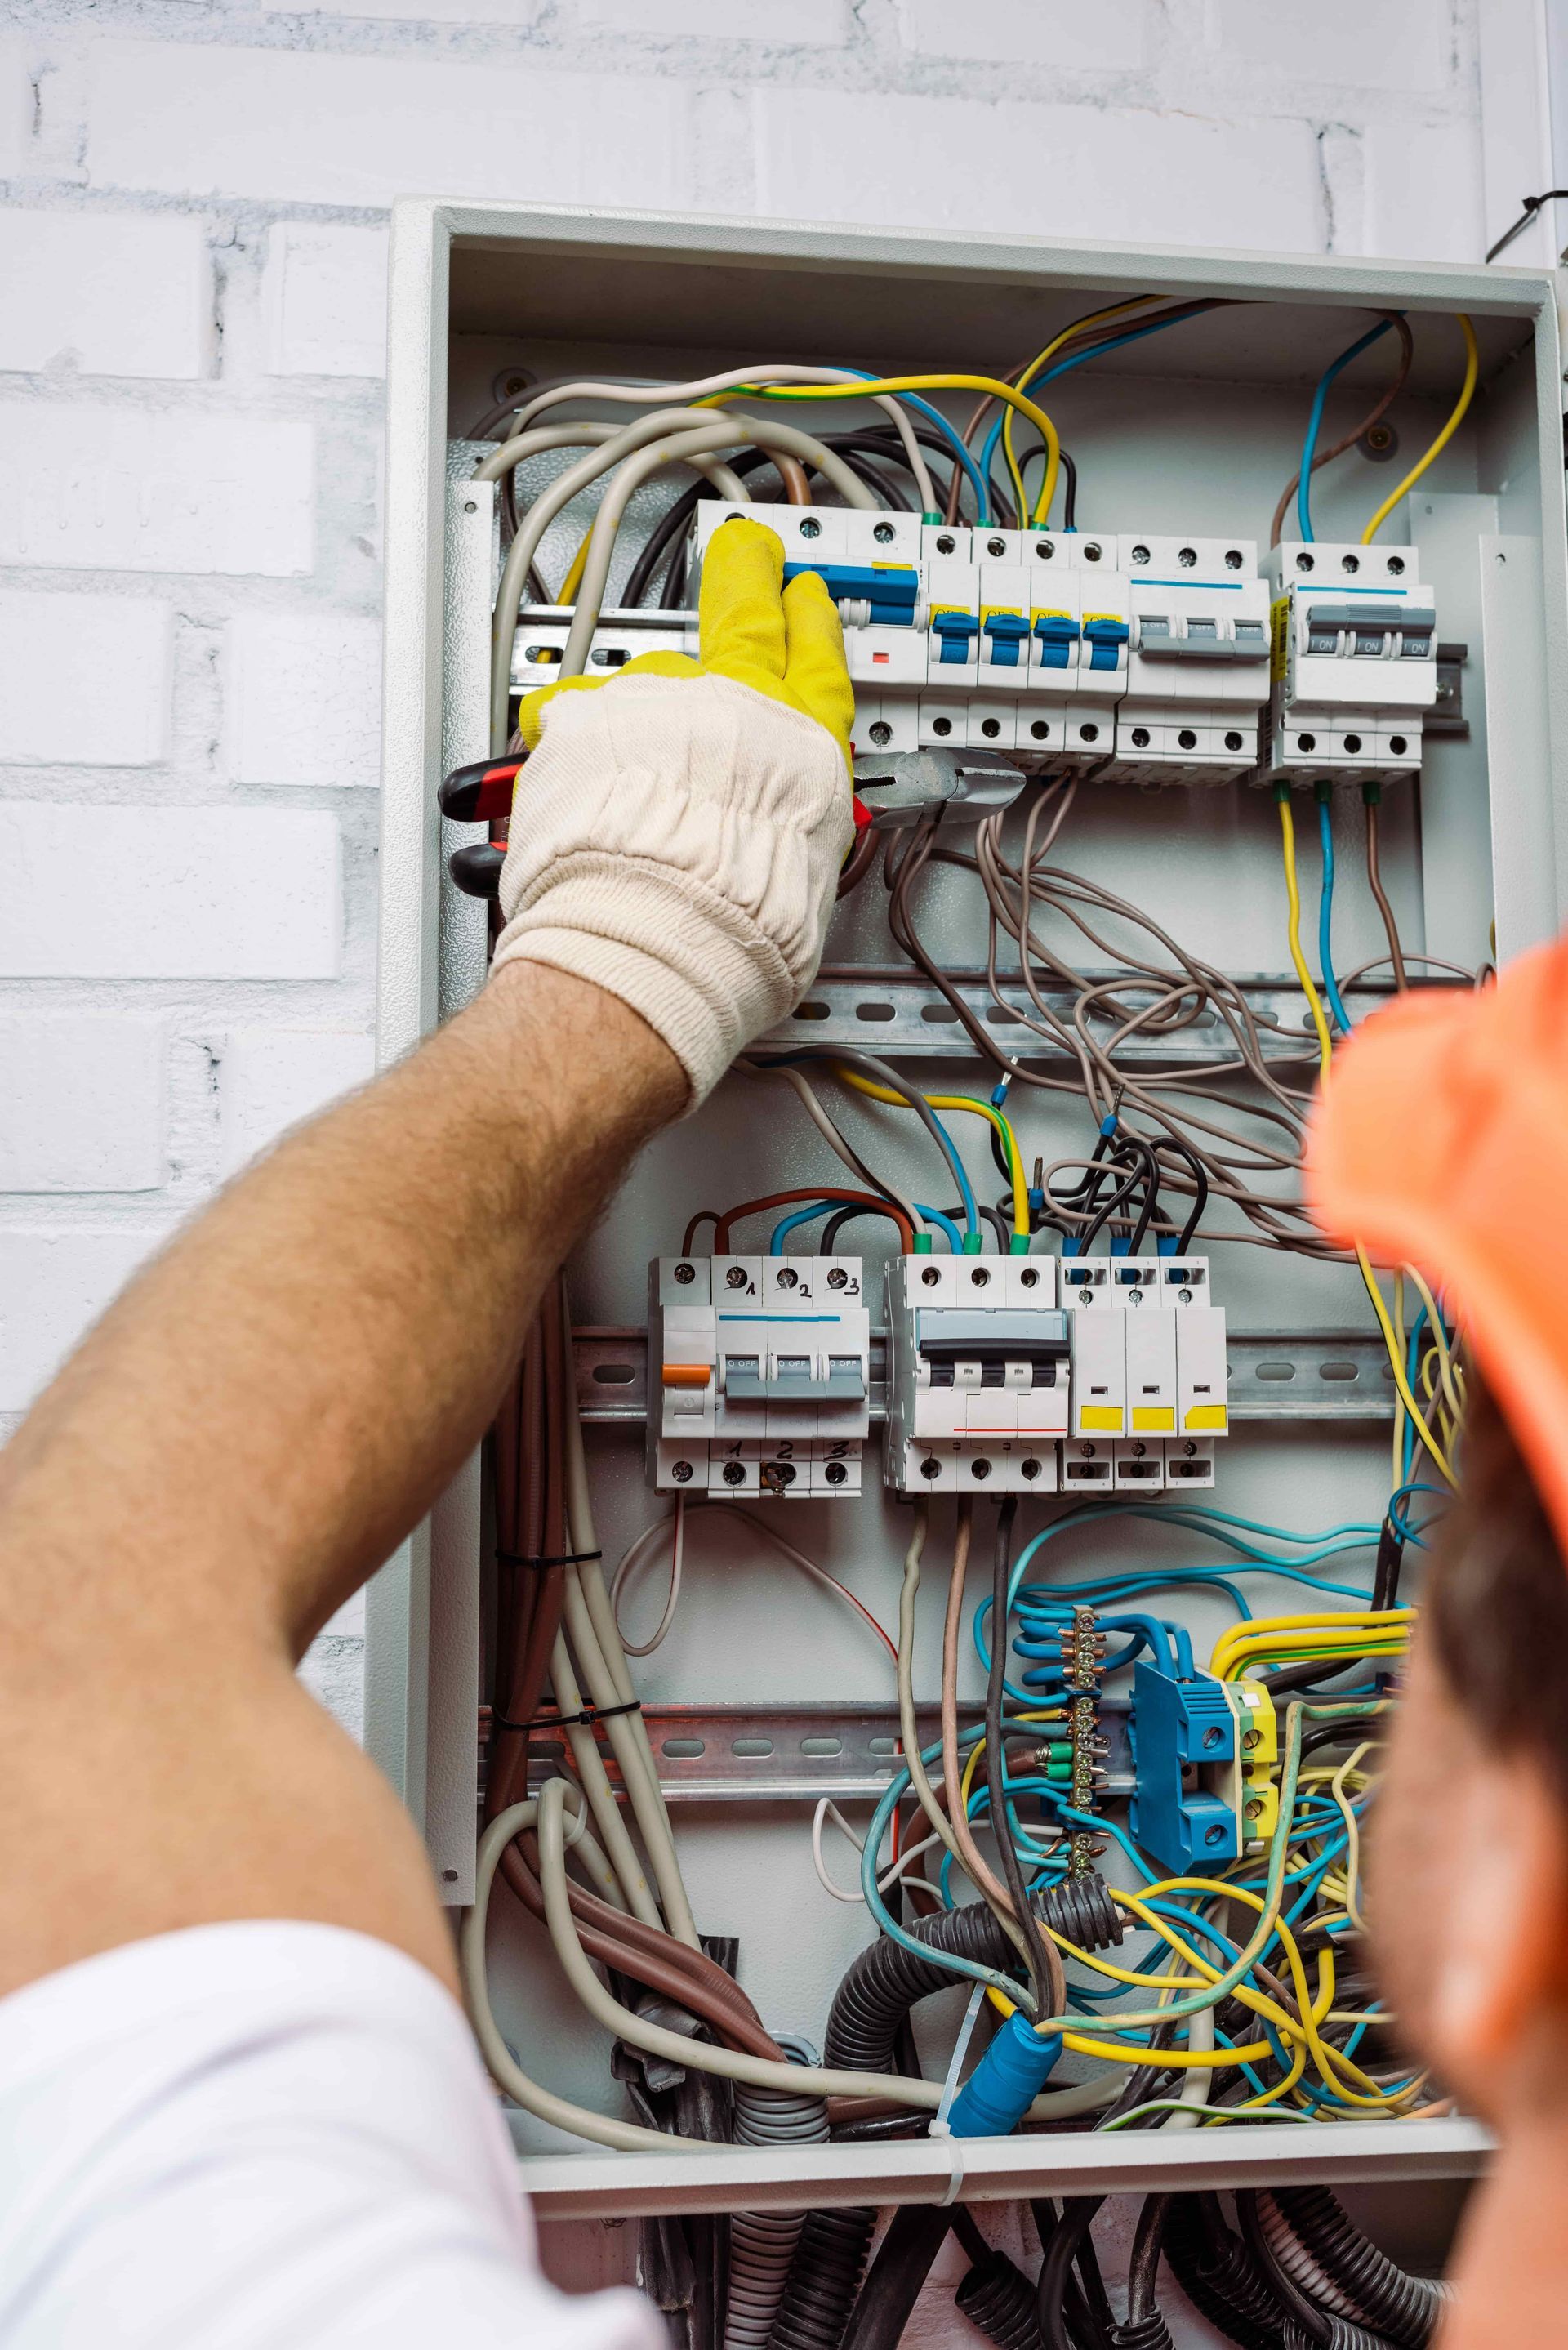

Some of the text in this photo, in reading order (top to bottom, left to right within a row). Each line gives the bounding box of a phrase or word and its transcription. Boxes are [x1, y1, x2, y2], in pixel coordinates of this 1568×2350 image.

[1319, 640, 1333, 651] ON
[1365, 641, 1379, 653] ON
[1411, 643, 1425, 654] ON
[746, 1282, 756, 1295] 1
[799, 1283, 813, 1298] 2
[844, 1278, 860, 1295] 3
[729, 1440, 742, 1457] 1
[776, 1440, 794, 1460] 2
[823, 1440, 850, 1460] 3
